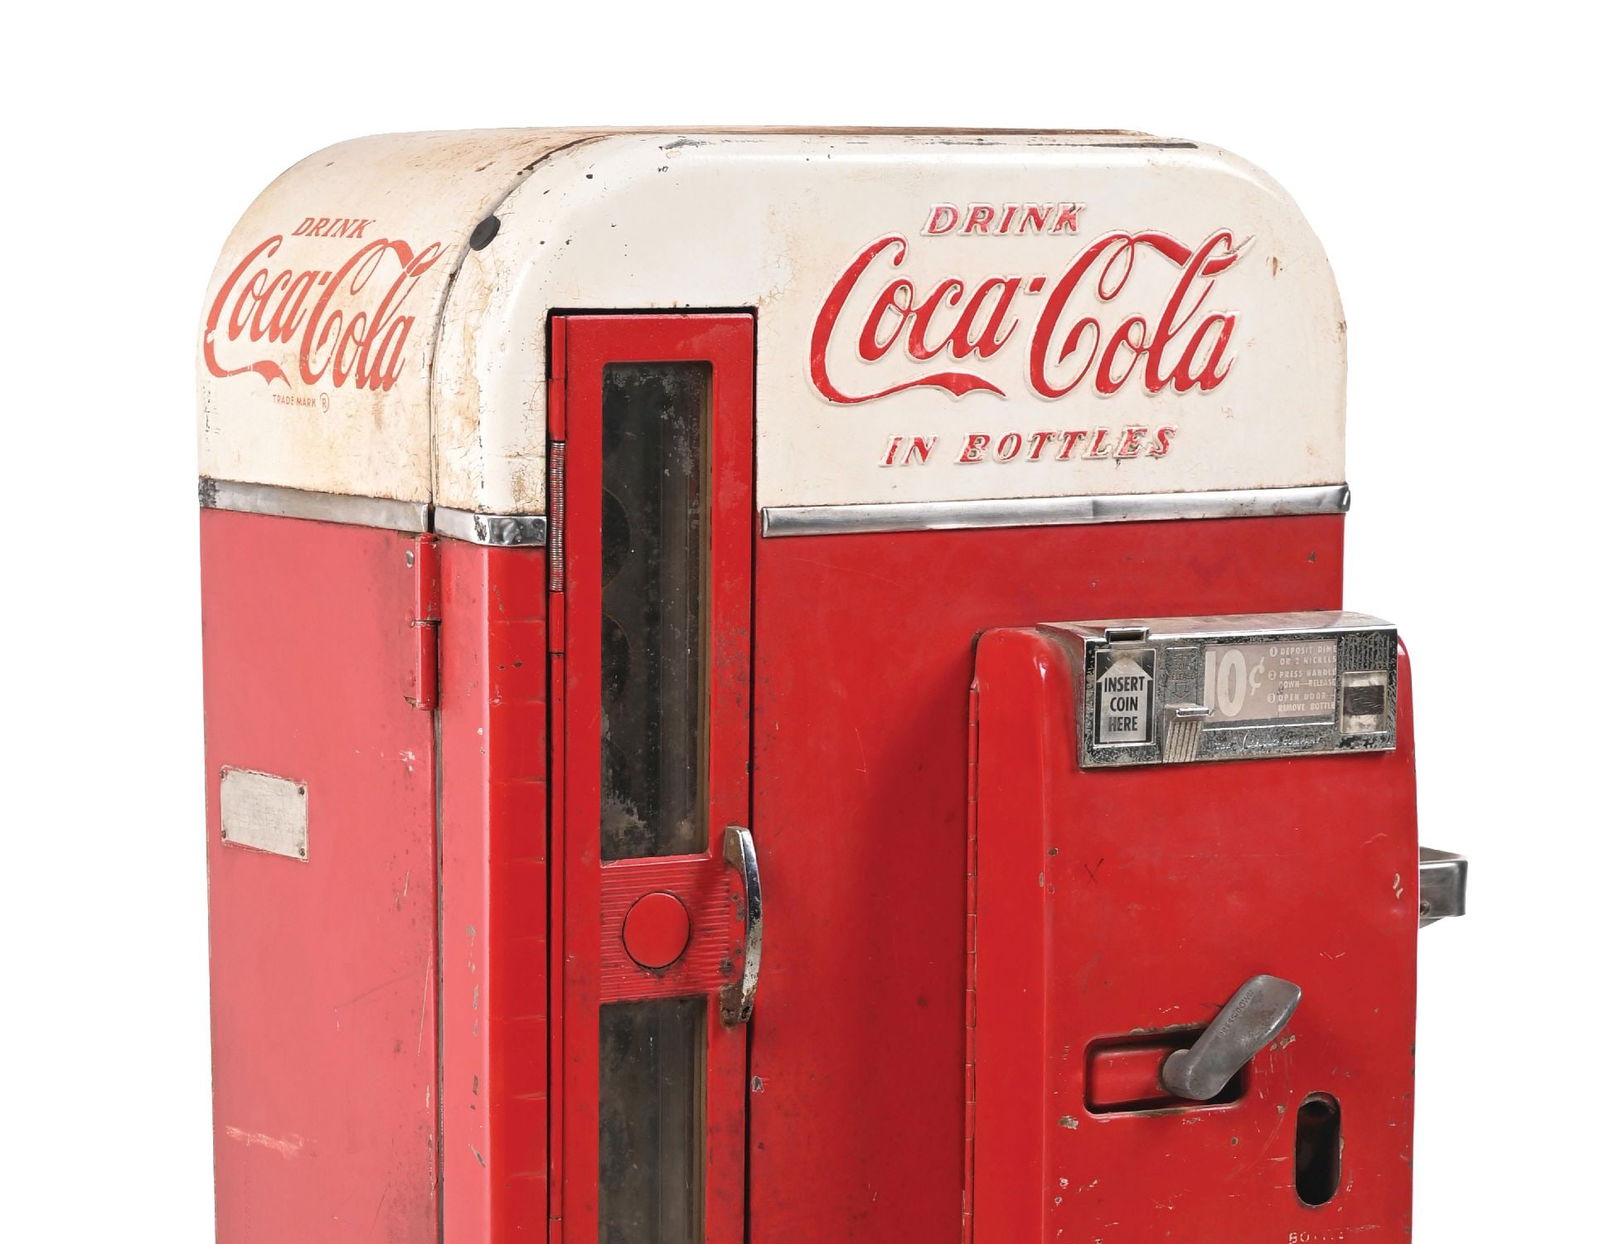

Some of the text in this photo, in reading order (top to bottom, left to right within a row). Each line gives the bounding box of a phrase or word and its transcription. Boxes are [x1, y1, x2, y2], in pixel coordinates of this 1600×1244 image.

[291, 217, 375, 238] DRINK
[921, 201, 1086, 238] DRINK
[203, 234, 451, 392] Coca-Cola
[806, 228, 1257, 405] Coca-Cola
[878, 424, 1179, 467] IN BOTTLES
[1104, 676, 1145, 692] INSERT
[1110, 696, 1138, 712] COIN
[1108, 716, 1138, 732] HERE
